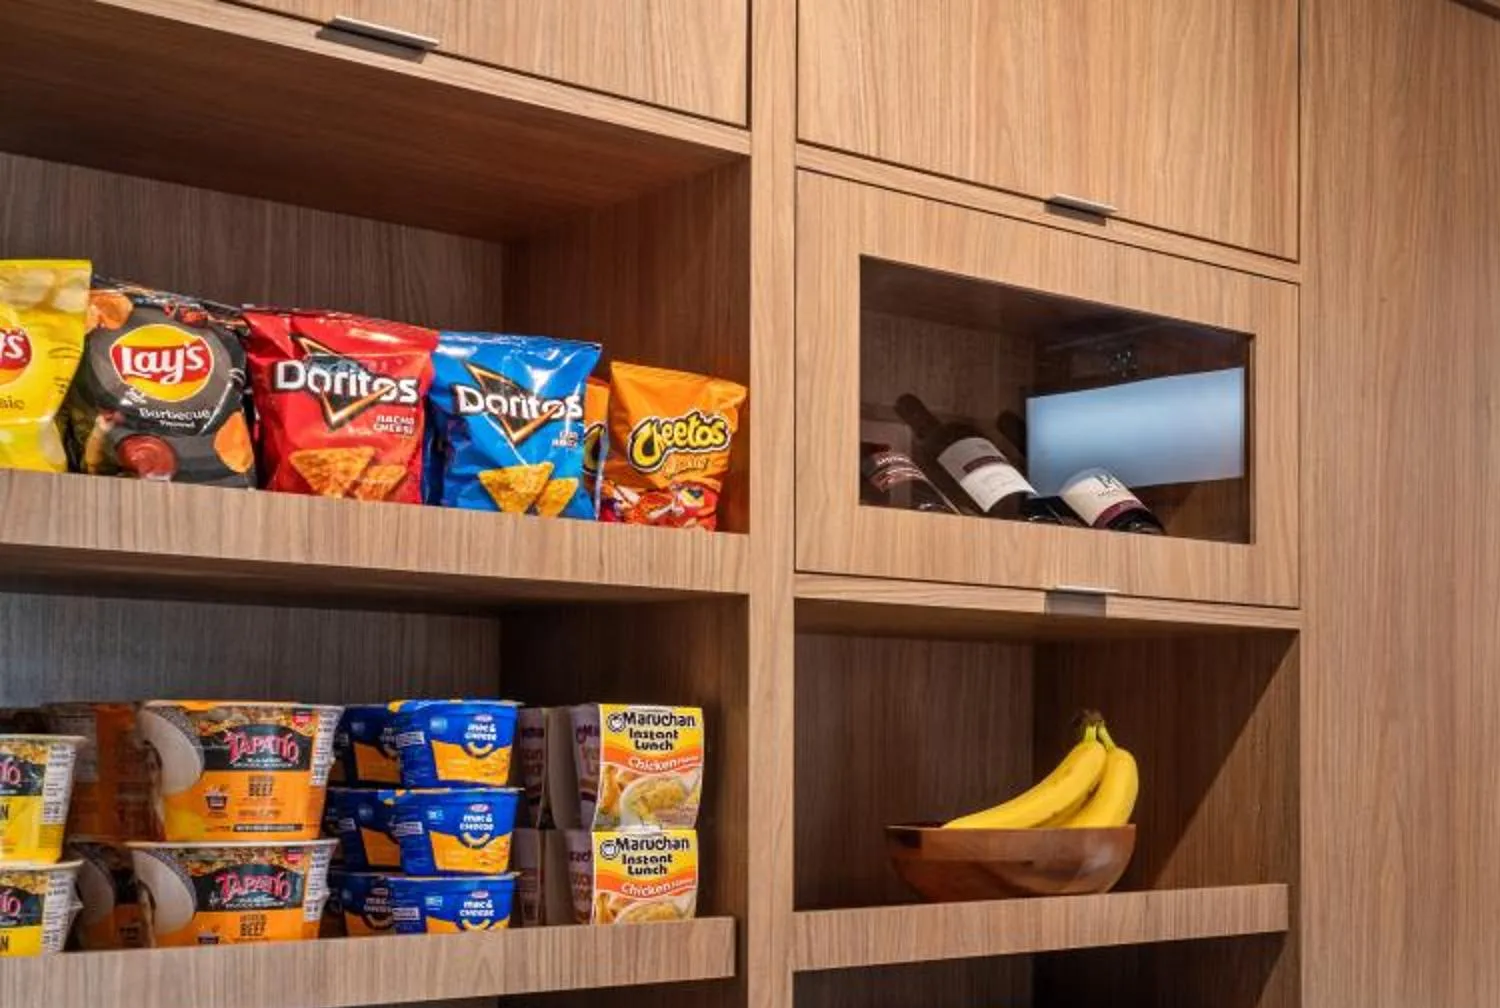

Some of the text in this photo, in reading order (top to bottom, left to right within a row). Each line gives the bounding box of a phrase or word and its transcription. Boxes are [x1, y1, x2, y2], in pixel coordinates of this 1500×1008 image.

[121, 343, 205, 385] Lay's
[276, 358, 419, 404] Doritos
[455, 384, 583, 420] Doritos
[630, 411, 729, 471] Cheetos
[623, 711, 696, 728] Maruchan
[629, 728, 679, 740] Instant
[635, 739, 673, 751] Lunch
[616, 836, 690, 851] Maruchan
[622, 853, 672, 865] Instant
[627, 865, 667, 875] Lunch
